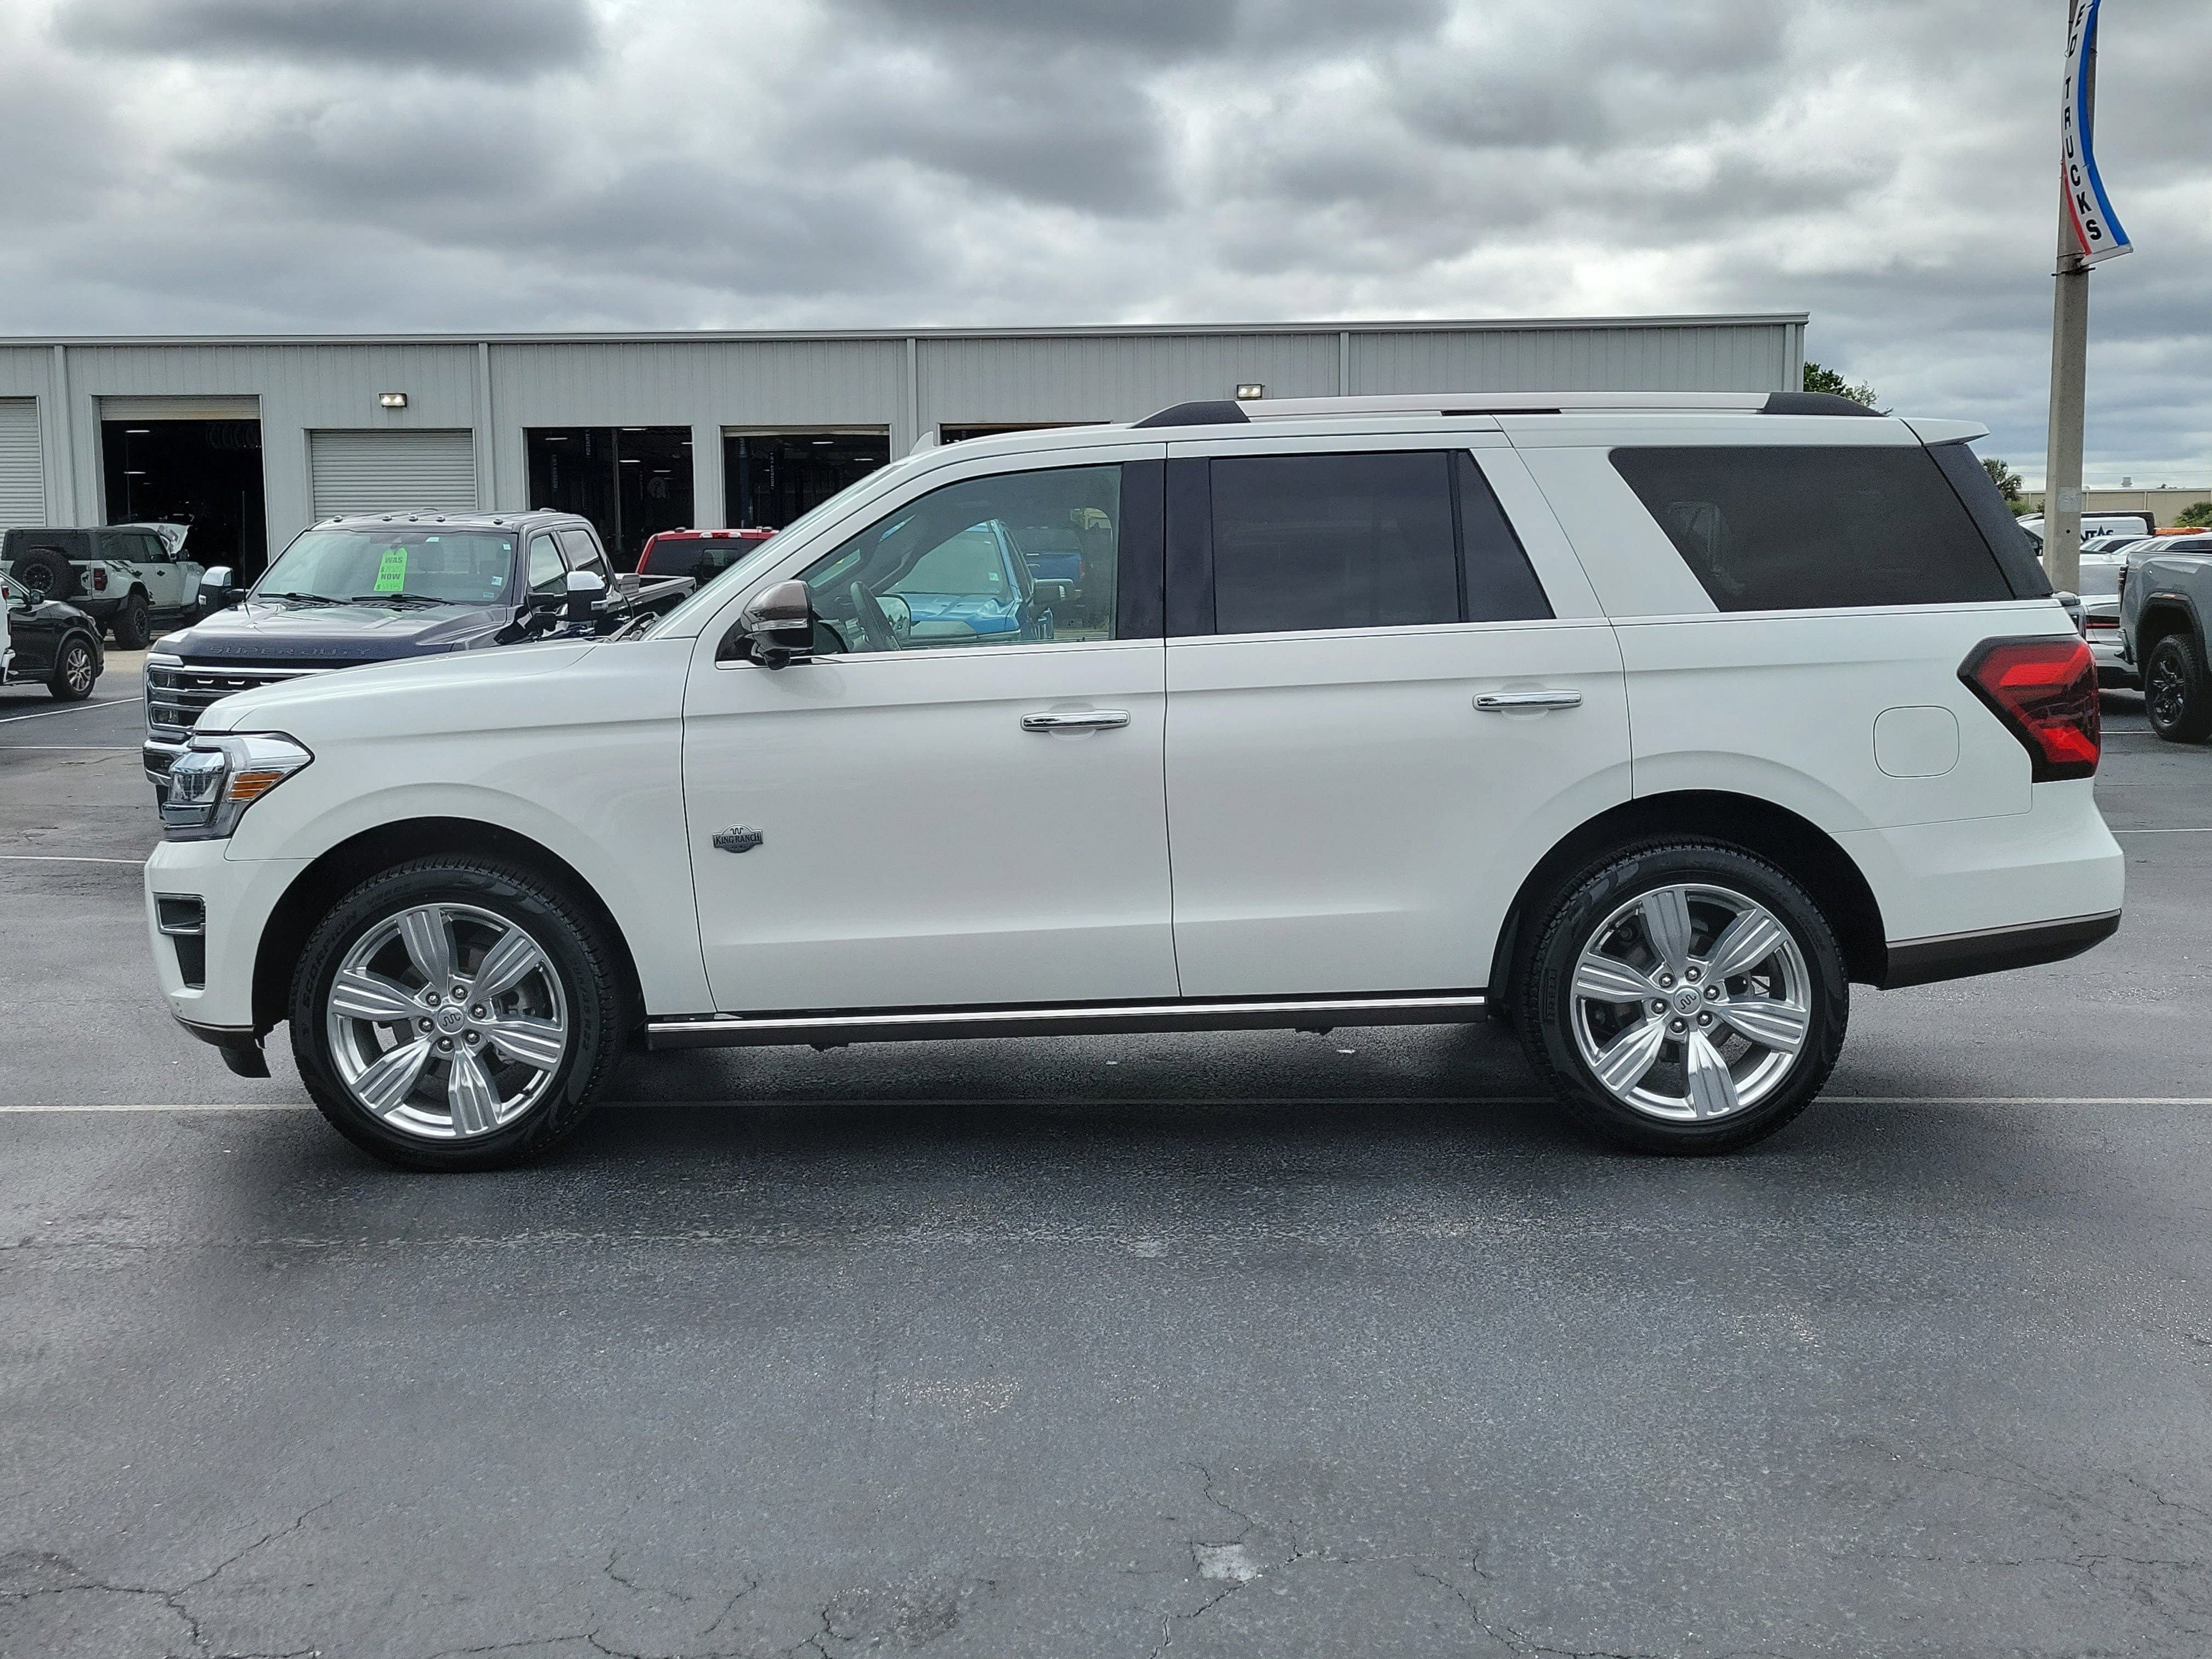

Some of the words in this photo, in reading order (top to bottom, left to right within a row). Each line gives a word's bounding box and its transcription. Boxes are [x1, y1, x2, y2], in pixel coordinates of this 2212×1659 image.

[2064, 77, 2102, 240] TRUCKS
[209, 646, 295, 655] SUPER
[715, 836, 733, 845] KING
[735, 833, 760, 843] RANCH
